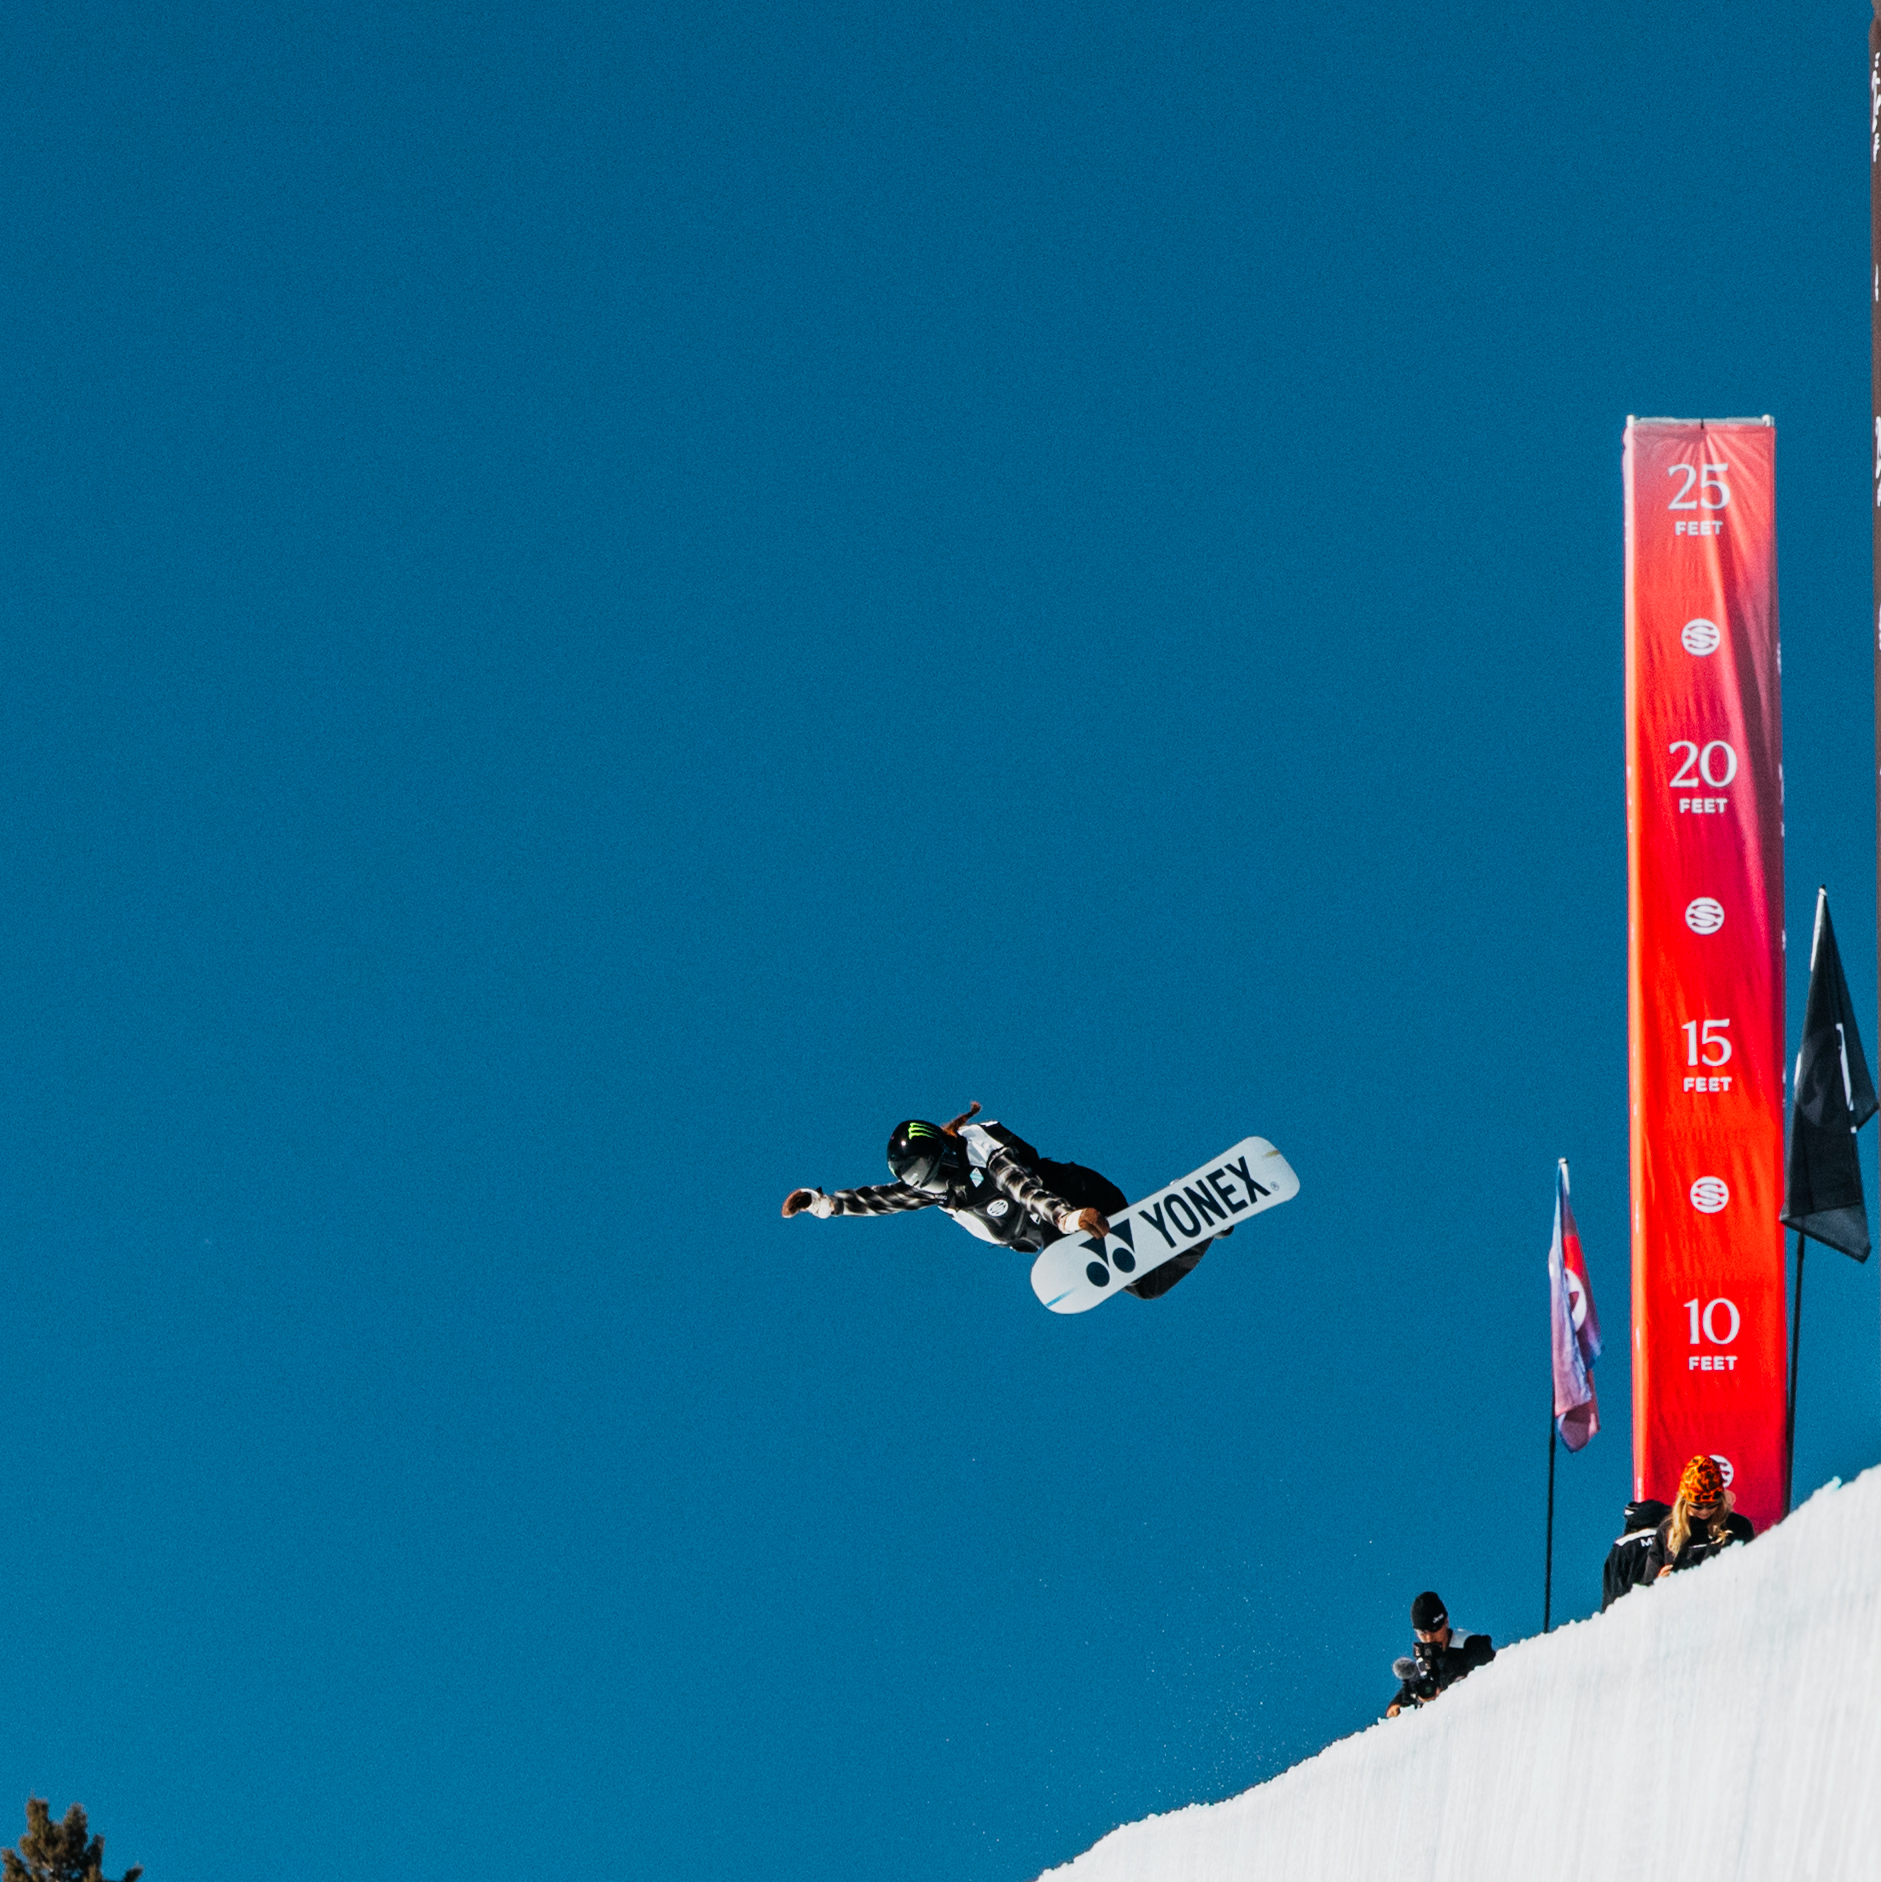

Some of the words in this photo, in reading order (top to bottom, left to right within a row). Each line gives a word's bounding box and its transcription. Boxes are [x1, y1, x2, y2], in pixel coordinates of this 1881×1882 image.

[1667, 462, 1732, 511] 25
[1674, 519, 1724, 537] FEET
[1668, 739, 1739, 788] 20
[1679, 797, 1729, 815] FEET
[1680, 1017, 1733, 1068] 15
[1683, 1076, 1733, 1093] FEET
[1138, 1156, 1271, 1249] YONEX
[1683, 1297, 1741, 1346] 10
[1688, 1355, 1738, 1372] FEET
